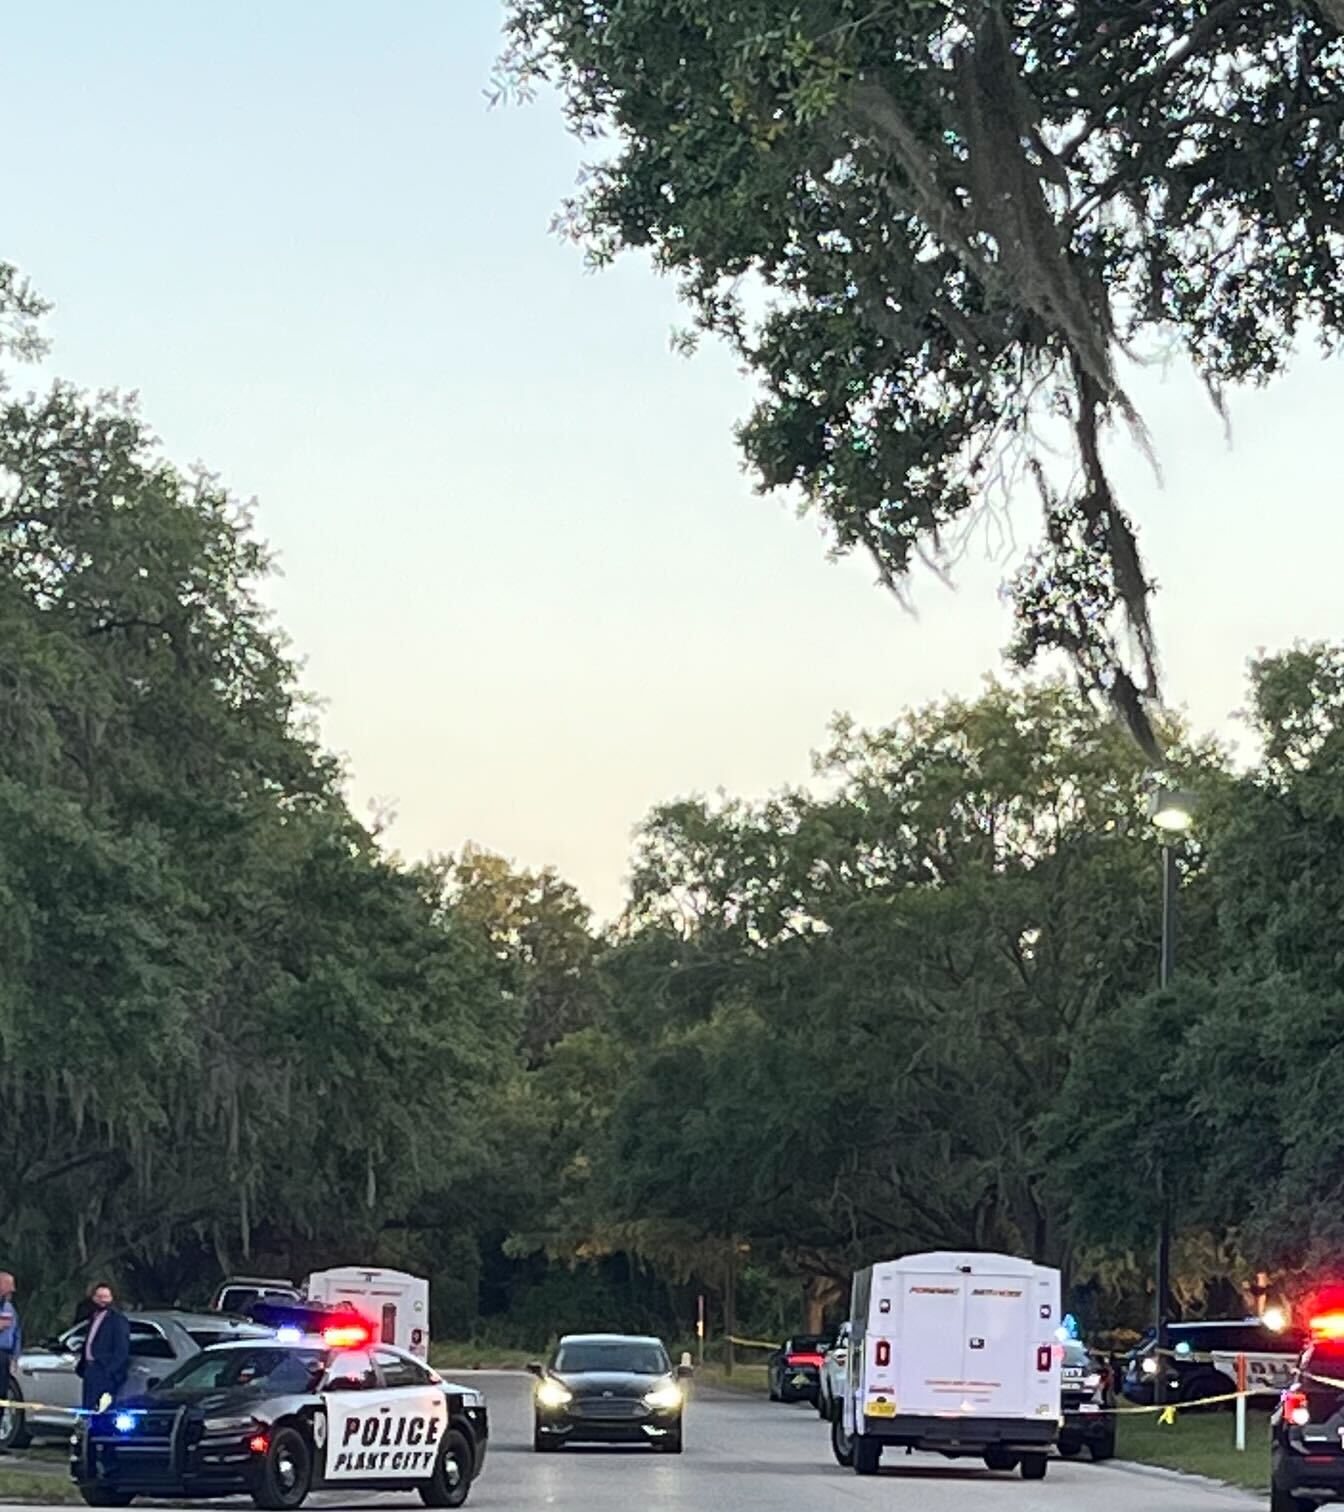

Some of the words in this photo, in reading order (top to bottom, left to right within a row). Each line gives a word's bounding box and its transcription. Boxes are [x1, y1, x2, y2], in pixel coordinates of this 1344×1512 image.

[342, 1417, 440, 1447] POLICE
[333, 1451, 390, 1472] PLANT
[392, 1451, 434, 1470] CITY
